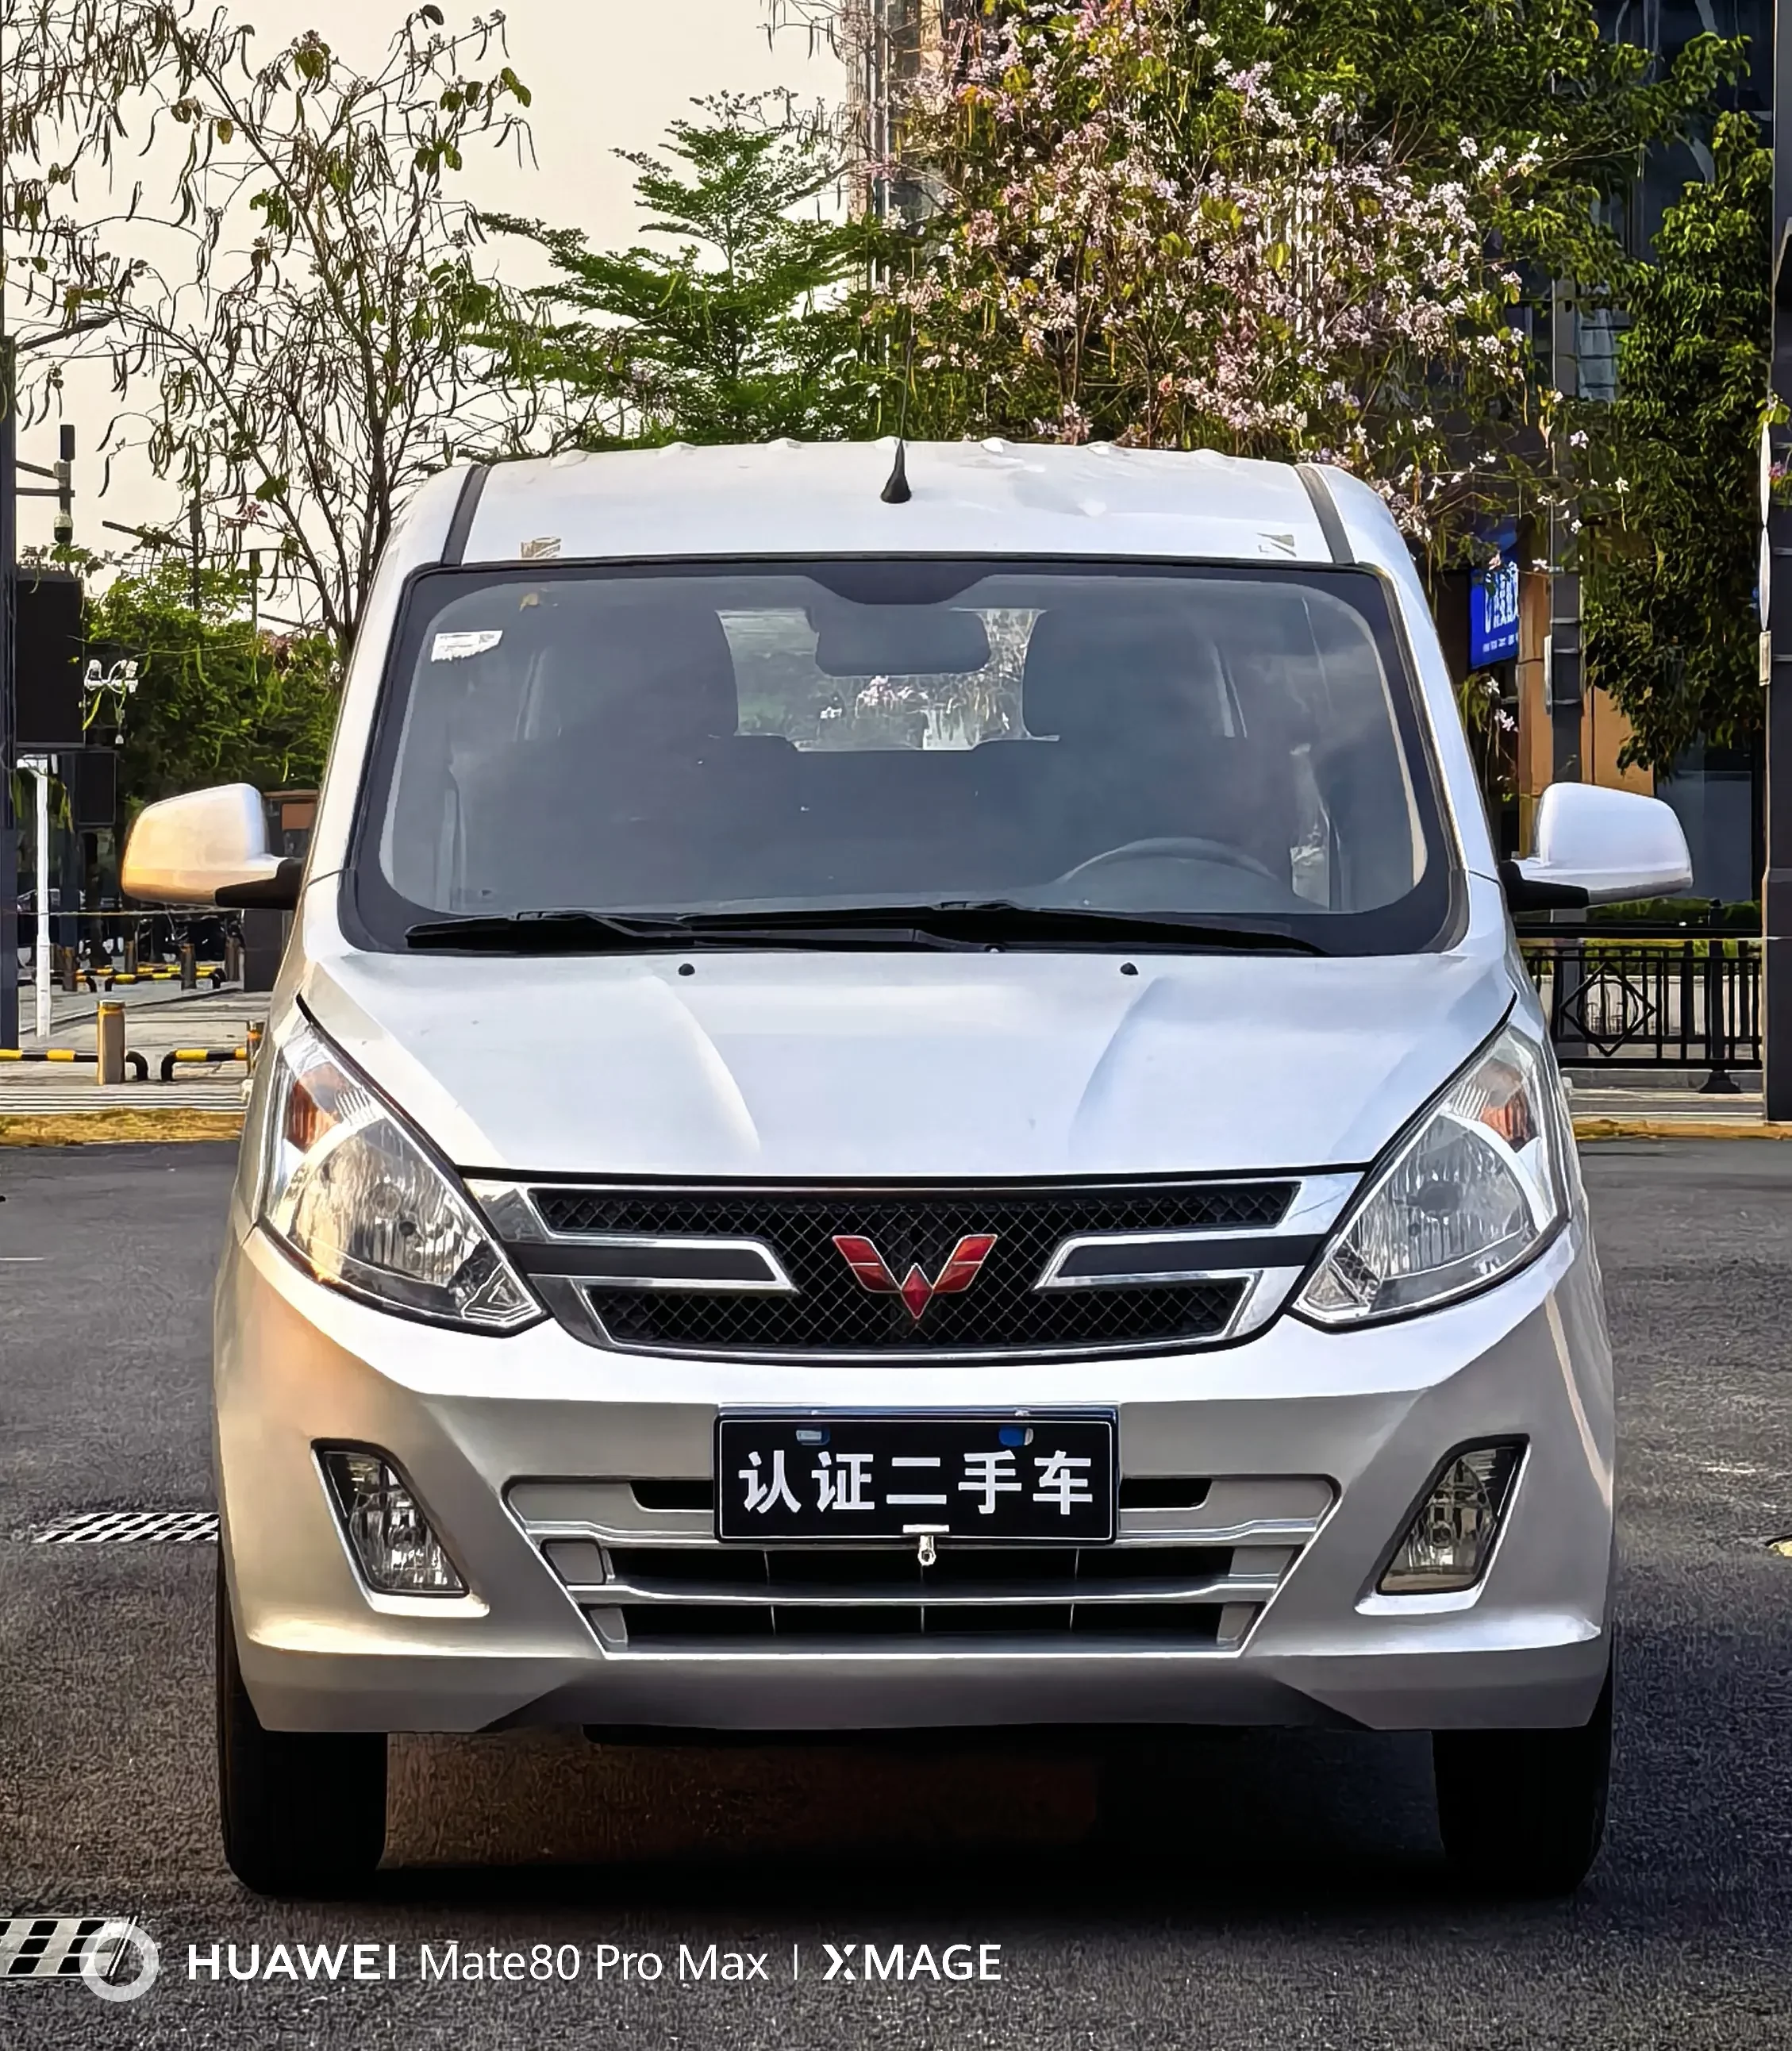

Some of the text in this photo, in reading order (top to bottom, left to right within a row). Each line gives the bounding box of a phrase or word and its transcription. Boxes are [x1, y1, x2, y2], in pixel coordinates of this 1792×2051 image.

[738, 1449, 1094, 1515] 认证二手车
